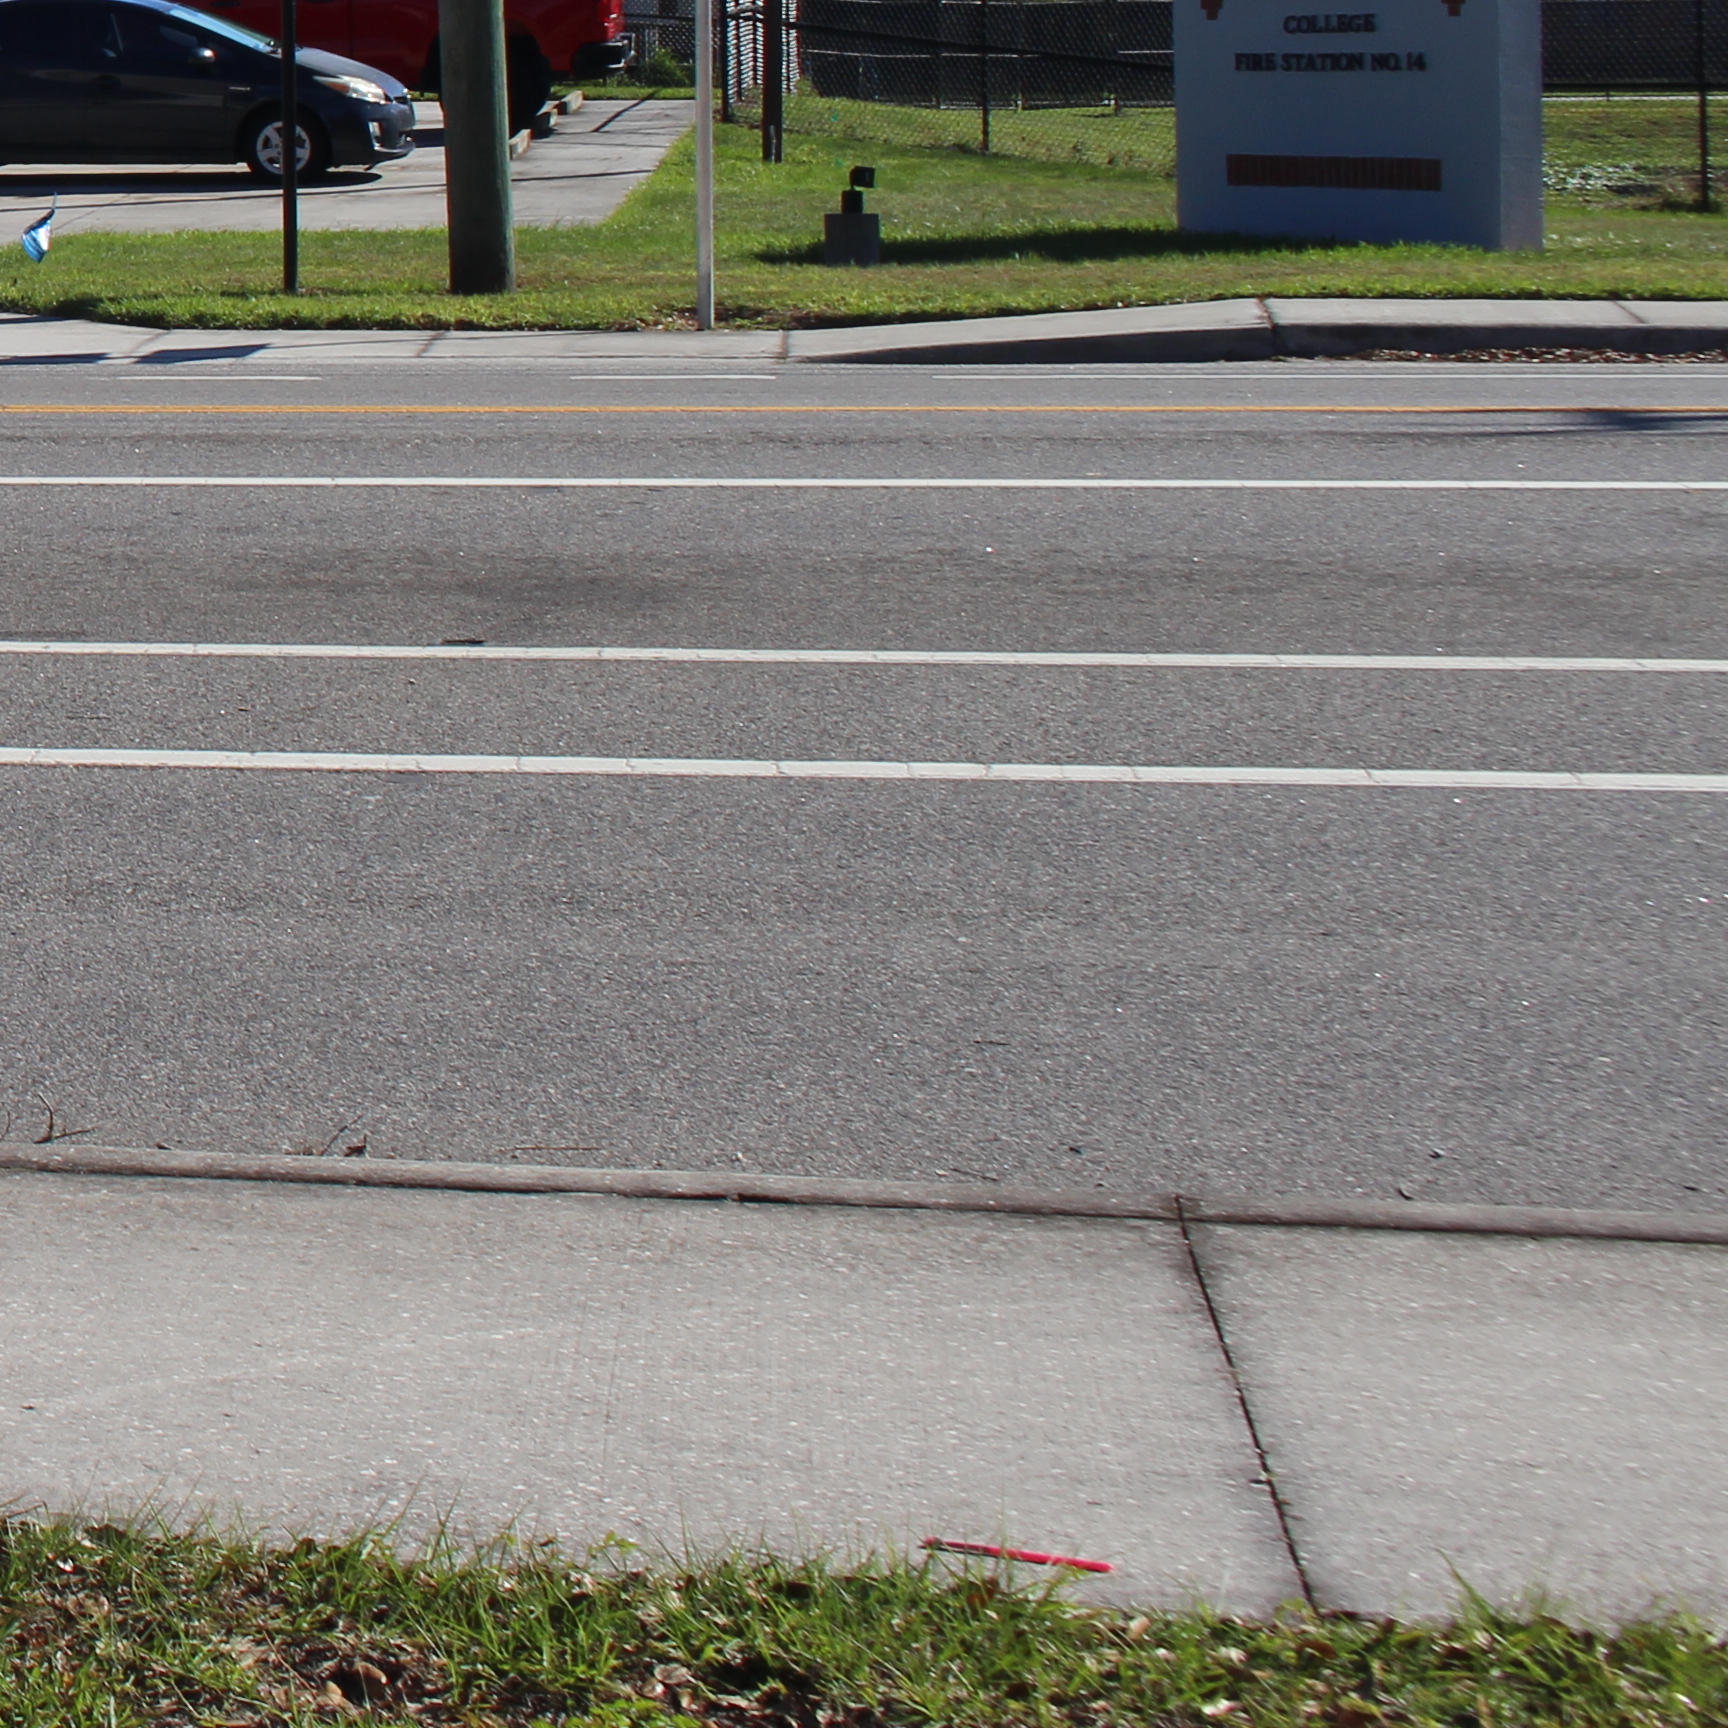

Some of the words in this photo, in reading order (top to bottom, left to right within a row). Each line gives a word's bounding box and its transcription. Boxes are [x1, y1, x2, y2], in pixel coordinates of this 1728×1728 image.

[1282, 13, 1377, 34] COLLEGE
[1234, 53, 1276, 72] FIRE
[1280, 52, 1365, 72] STATION
[1406, 52, 1428, 71] 14
